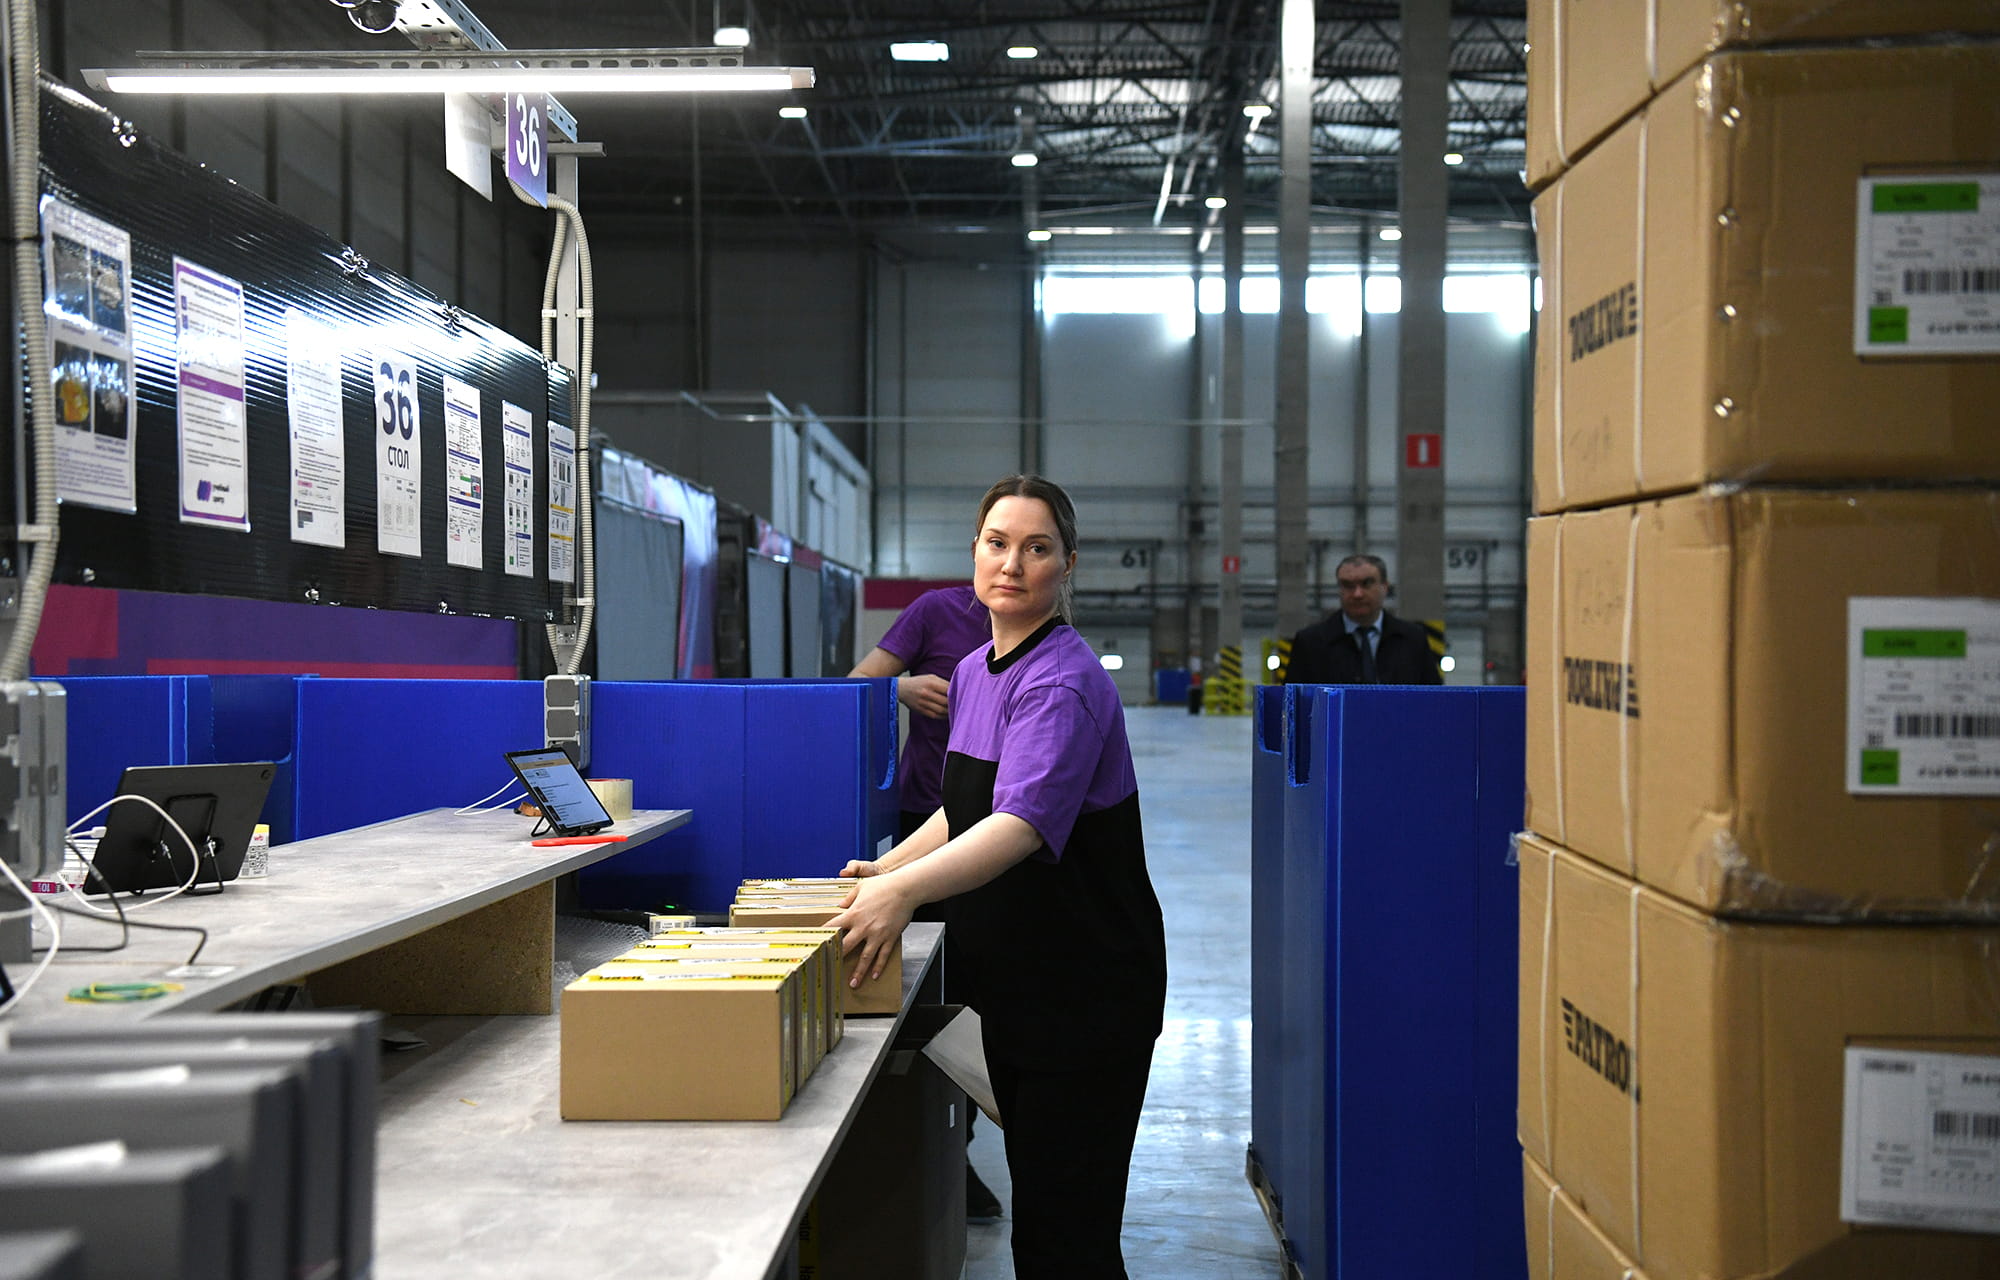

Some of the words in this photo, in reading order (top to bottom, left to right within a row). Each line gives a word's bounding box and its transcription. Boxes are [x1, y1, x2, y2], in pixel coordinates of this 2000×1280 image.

[515, 93, 540, 177] 36
[380, 361, 414, 441] 36
[387, 445, 410, 470] СТОЛ
[1121, 548, 1146, 568] 61
[1447, 547, 1478, 569] 59
